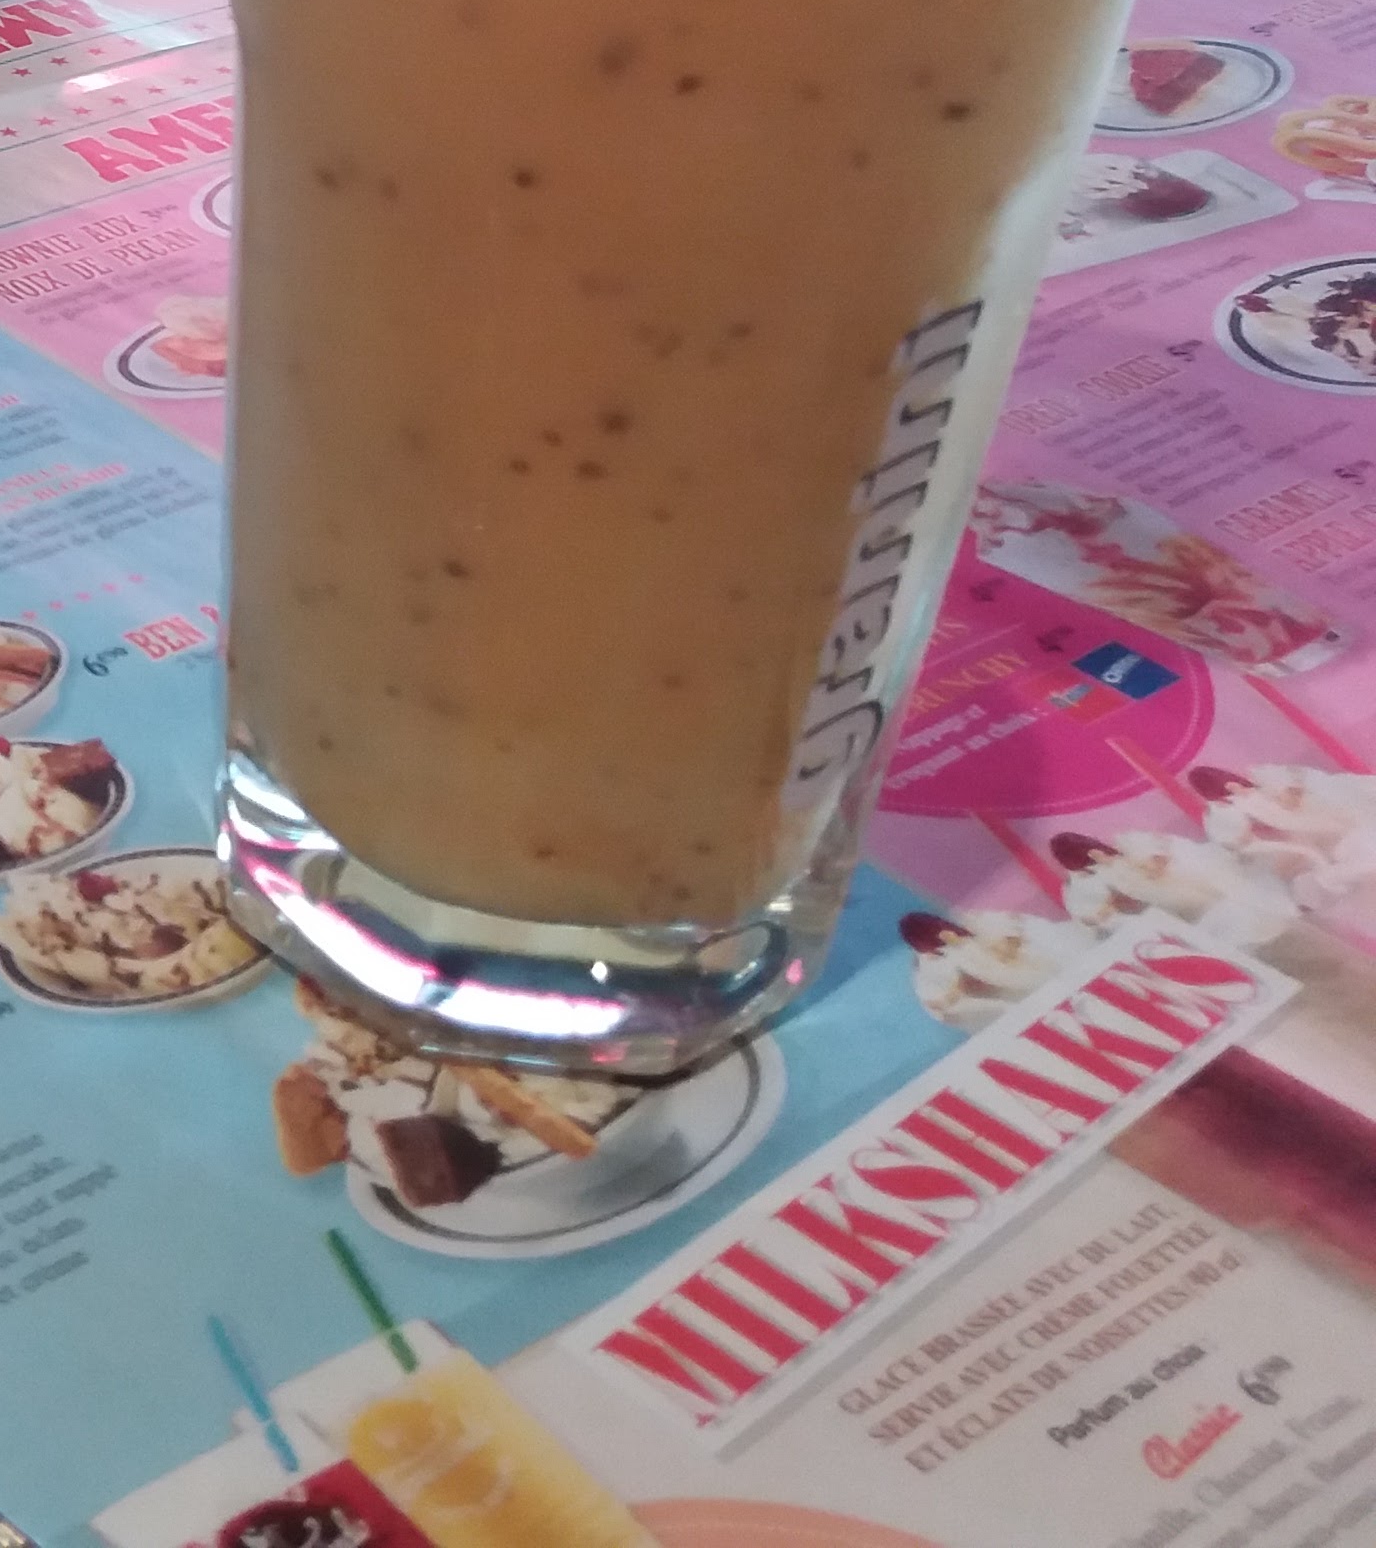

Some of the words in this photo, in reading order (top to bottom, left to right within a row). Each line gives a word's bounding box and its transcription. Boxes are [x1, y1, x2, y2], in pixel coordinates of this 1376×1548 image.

[79, 214, 148, 244] AUX
[63, 255, 114, 281] DE
[779, 299, 984, 812] granini
[123, 615, 208, 660] BEN
[595, 931, 1258, 1429] MILKSHAKES
[837, 1355, 926, 1416] GLACE
[1024, 1255, 1080, 1301] AVEC
[1076, 1237, 1115, 1266] DU
[958, 1345, 1018, 1389] AVEC
[1030, 1360, 1070, 1391] DE
[1046, 1394, 1129, 1448] Parfum
